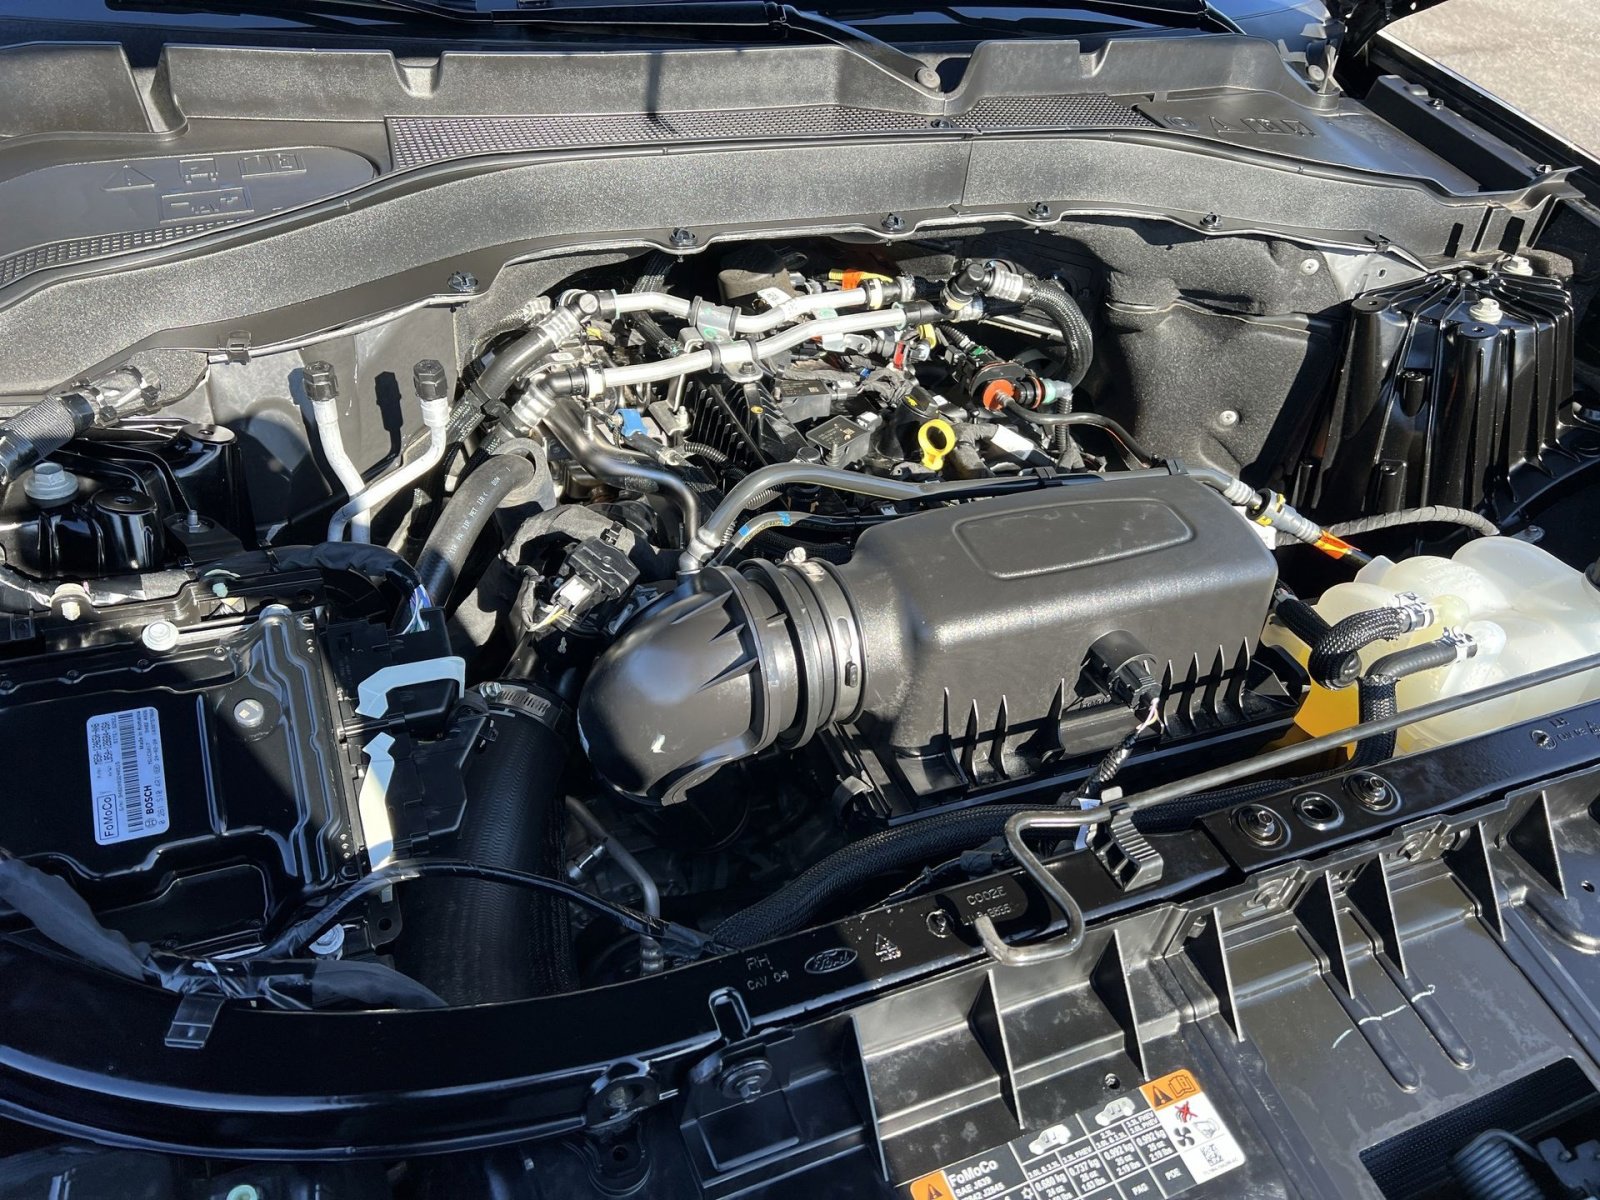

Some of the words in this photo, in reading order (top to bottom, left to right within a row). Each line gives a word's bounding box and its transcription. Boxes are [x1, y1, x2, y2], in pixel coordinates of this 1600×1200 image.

[143, 784, 153, 815] BOSCH
[102, 796, 114, 837] FoMoCo
[1154, 1127, 1168, 1140] kg
[1122, 1141, 1136, 1154] kg
[1087, 1158, 1101, 1169] kg
[947, 1160, 999, 1188] FoMoCo
[1054, 1173, 1068, 1184] kg
[955, 1184, 974, 1198] SAE
